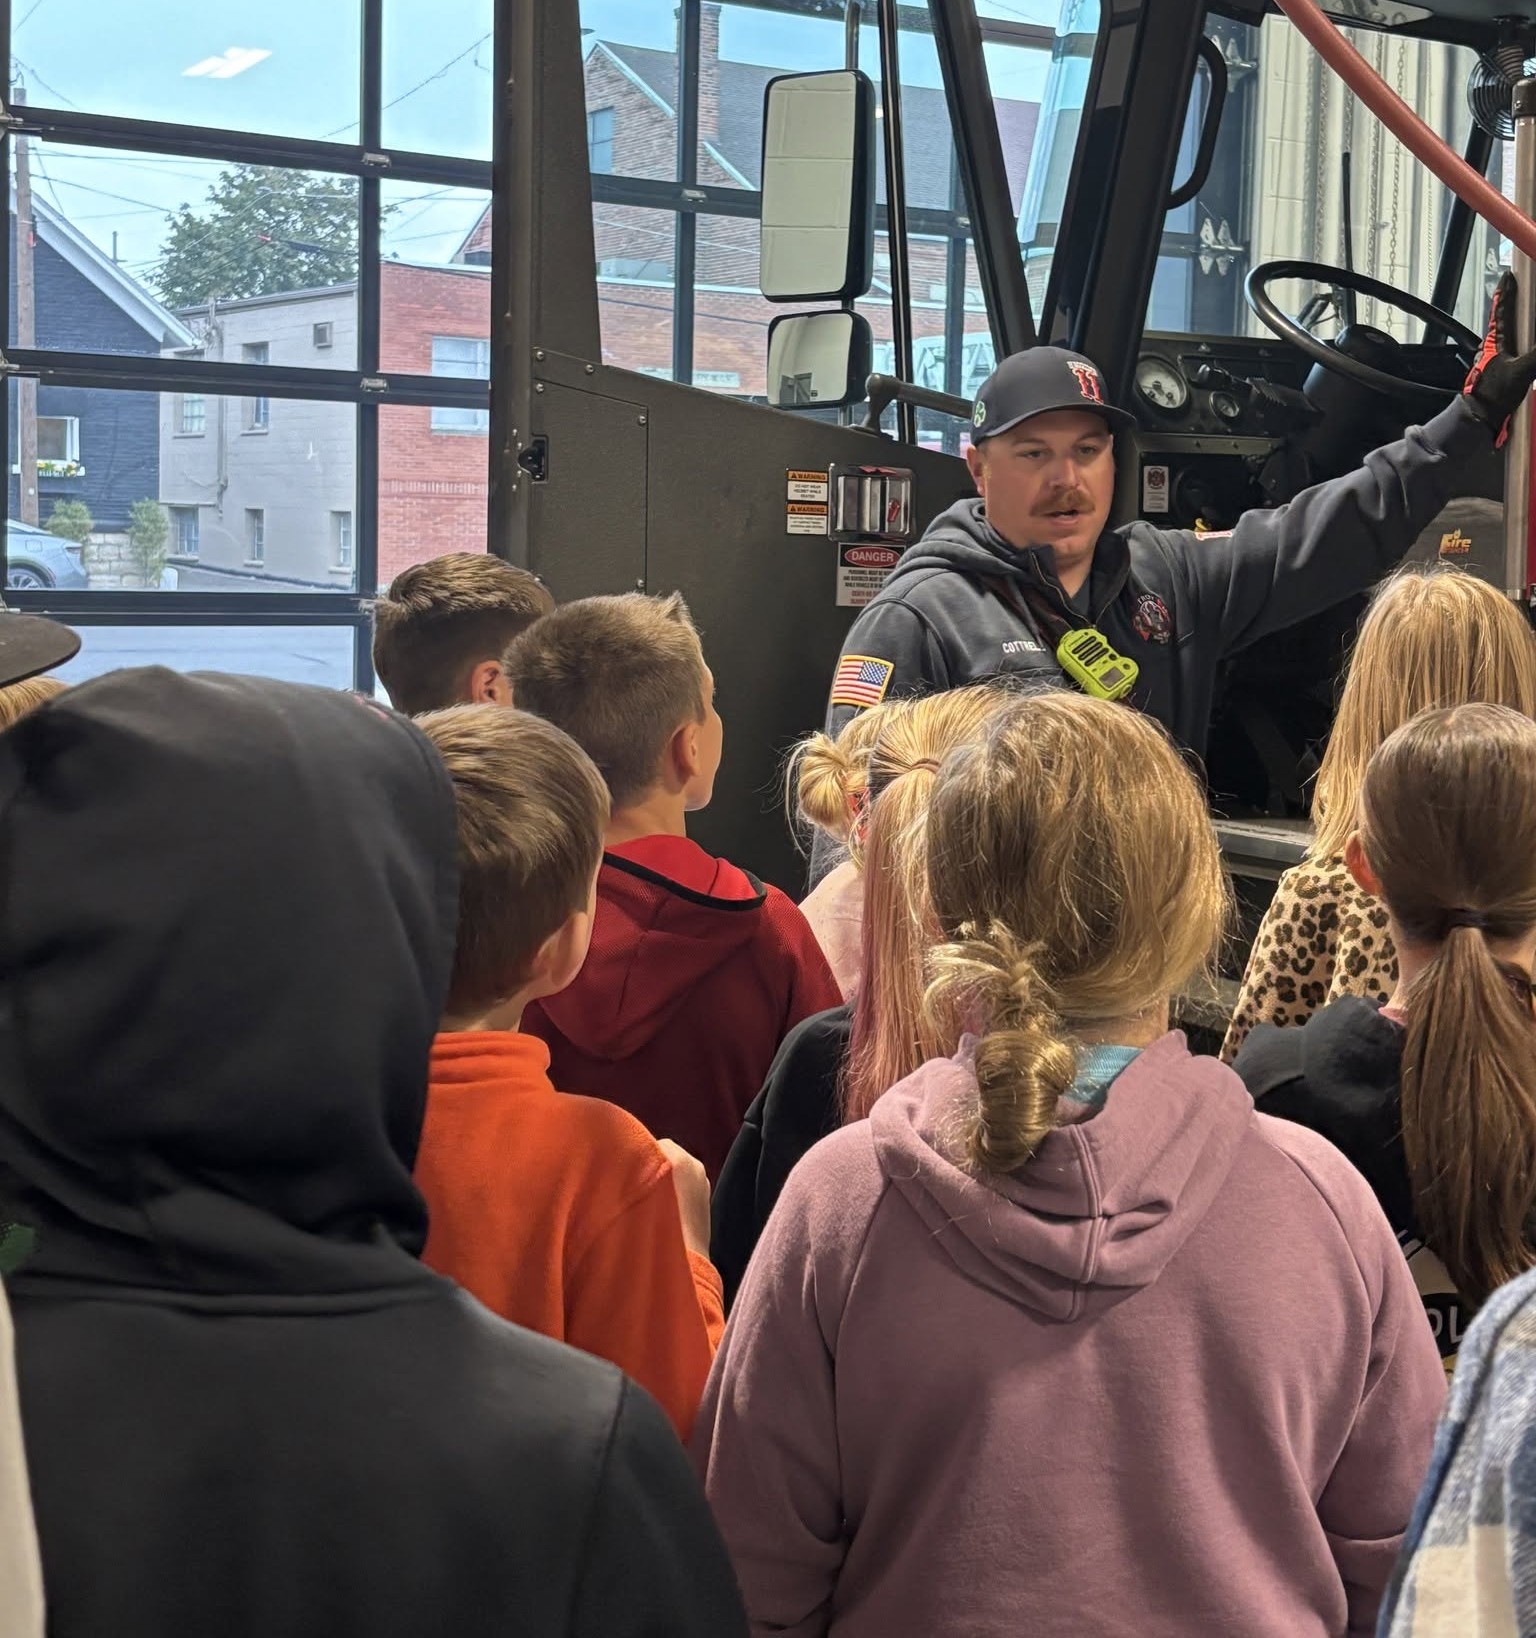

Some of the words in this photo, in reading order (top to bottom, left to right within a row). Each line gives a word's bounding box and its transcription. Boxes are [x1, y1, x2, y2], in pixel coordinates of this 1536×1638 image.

[797, 472, 826, 480] WARNING
[796, 505, 825, 513] WARNING
[851, 551, 894, 562] DANGER
[1137, 594, 1154, 605] TROY
[1002, 640, 1046, 654] COTTREL
